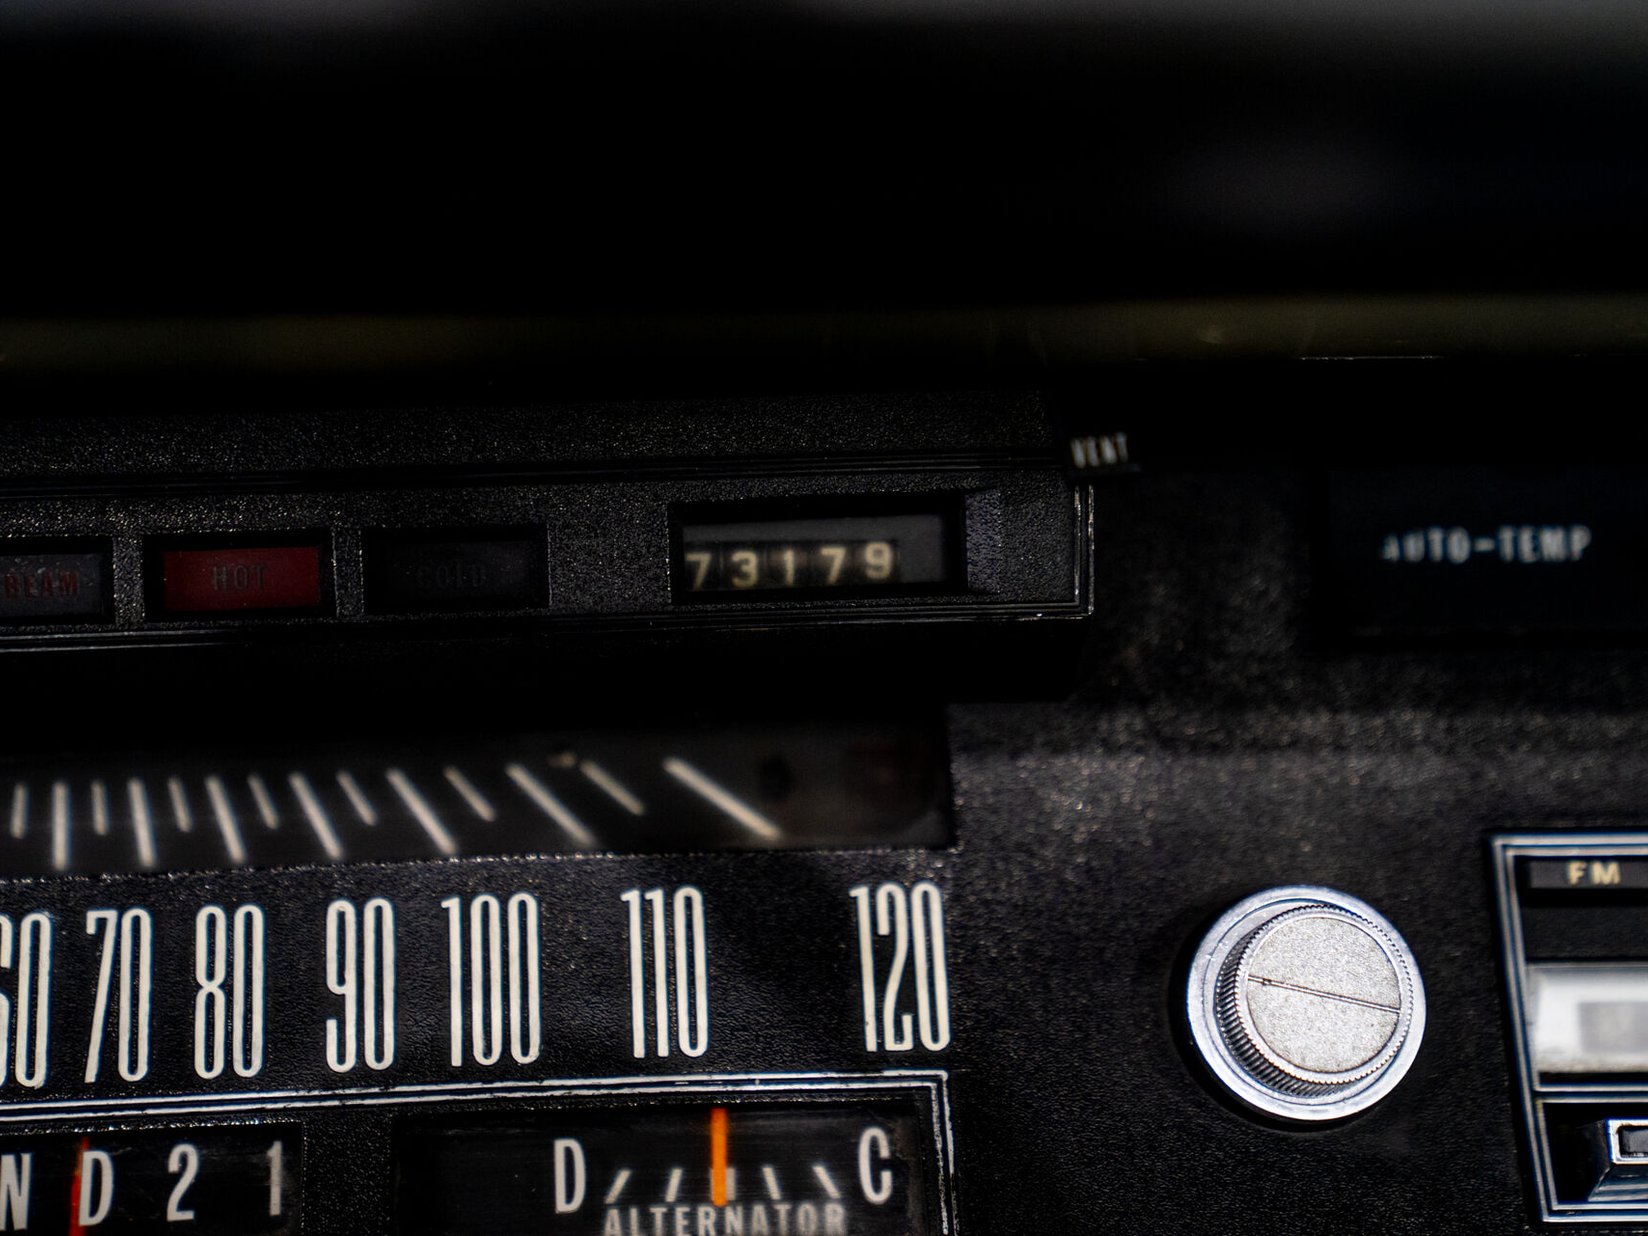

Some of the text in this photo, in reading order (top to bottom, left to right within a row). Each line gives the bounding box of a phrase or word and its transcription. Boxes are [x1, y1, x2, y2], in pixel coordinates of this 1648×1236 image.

[1380, 523, 1592, 565] AUTO-TEMP
[4, 568, 79, 600] BEAM
[211, 564, 267, 592] HOT
[416, 559, 487, 588] COLD
[684, 540, 896, 592] 73179
[1566, 860, 1622, 886] FM
[84, 907, 153, 1084] 70
[193, 904, 264, 1080] 80
[325, 898, 396, 1074] 90
[440, 892, 542, 1067] 100
[620, 885, 710, 1059] 110
[848, 880, 951, 1053] 120
[0, 1138, 284, 1232] N D 2 1
[552, 1126, 893, 1214] D C
[603, 1203, 847, 1236] ALTERNATOR
